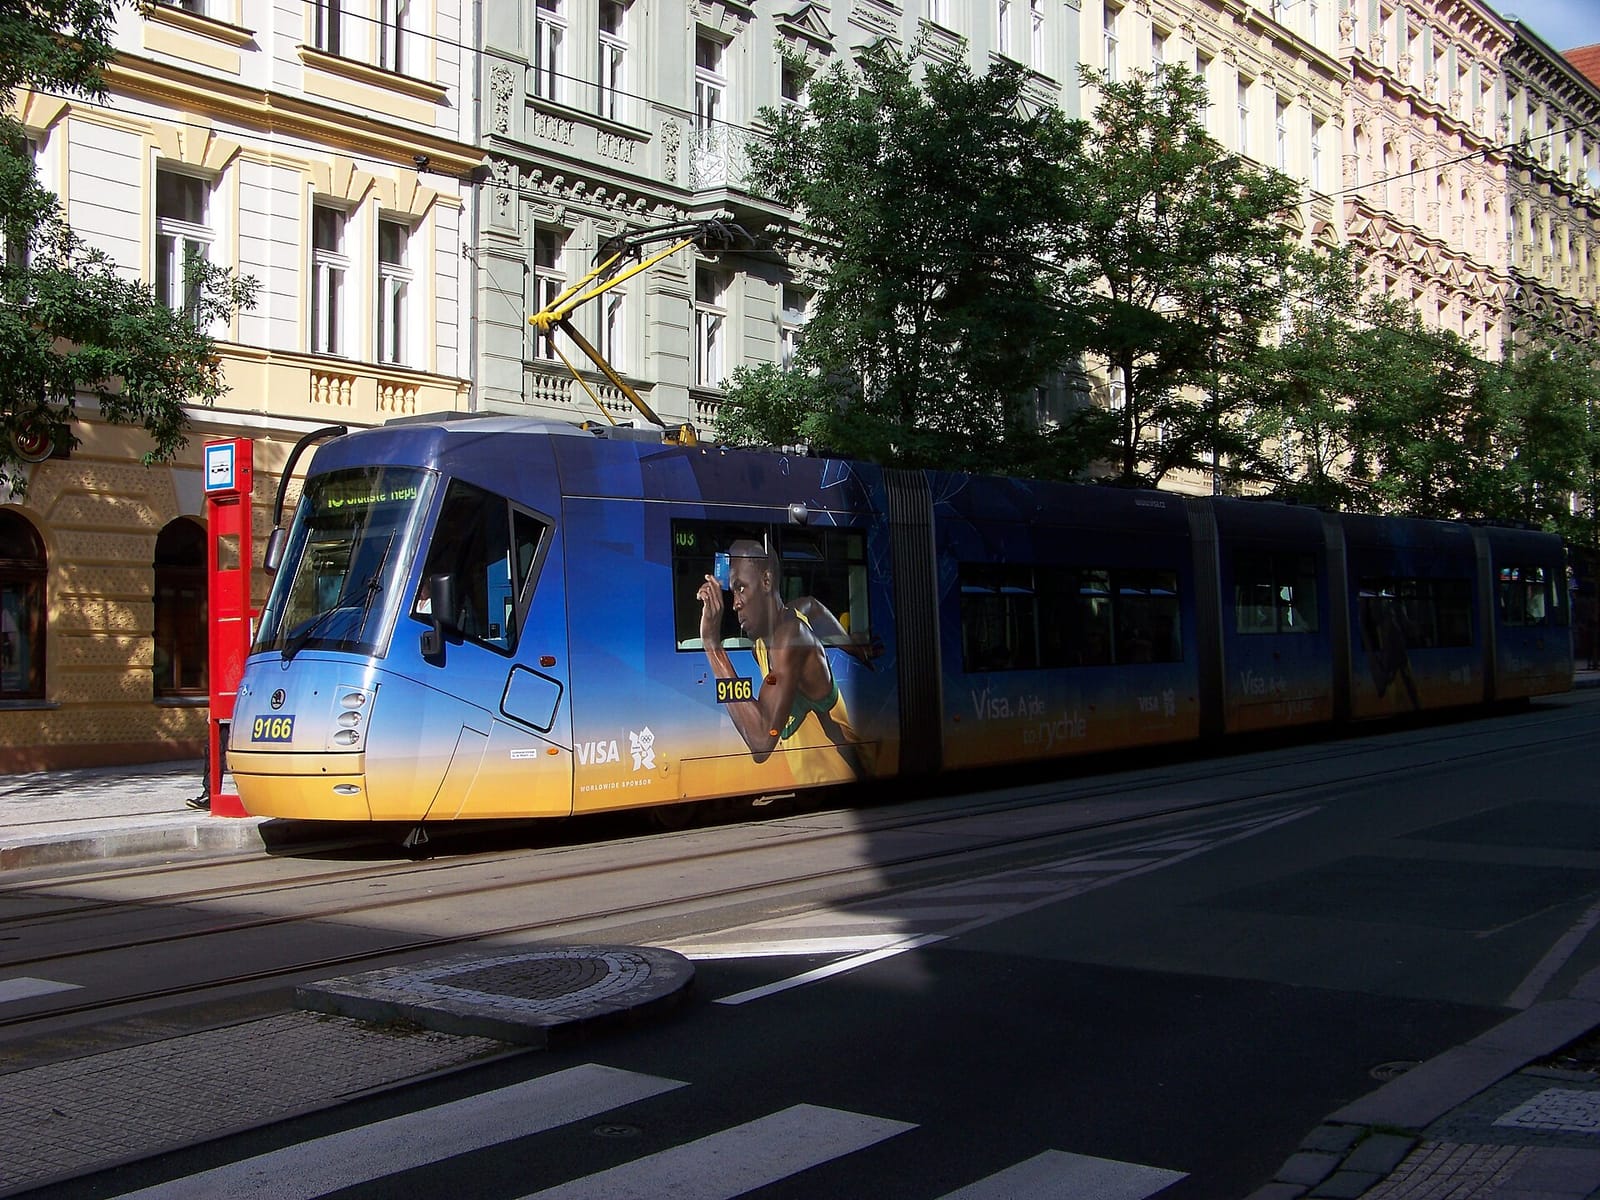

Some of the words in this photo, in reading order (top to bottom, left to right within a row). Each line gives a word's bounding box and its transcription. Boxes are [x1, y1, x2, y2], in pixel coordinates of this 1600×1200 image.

[717, 680, 752, 701] 9166
[253, 717, 292, 739] 9166
[573, 740, 620, 765] VISA
[580, 782, 619, 792] WORLDWIDE
[622, 778, 652, 788] SPONSOR
